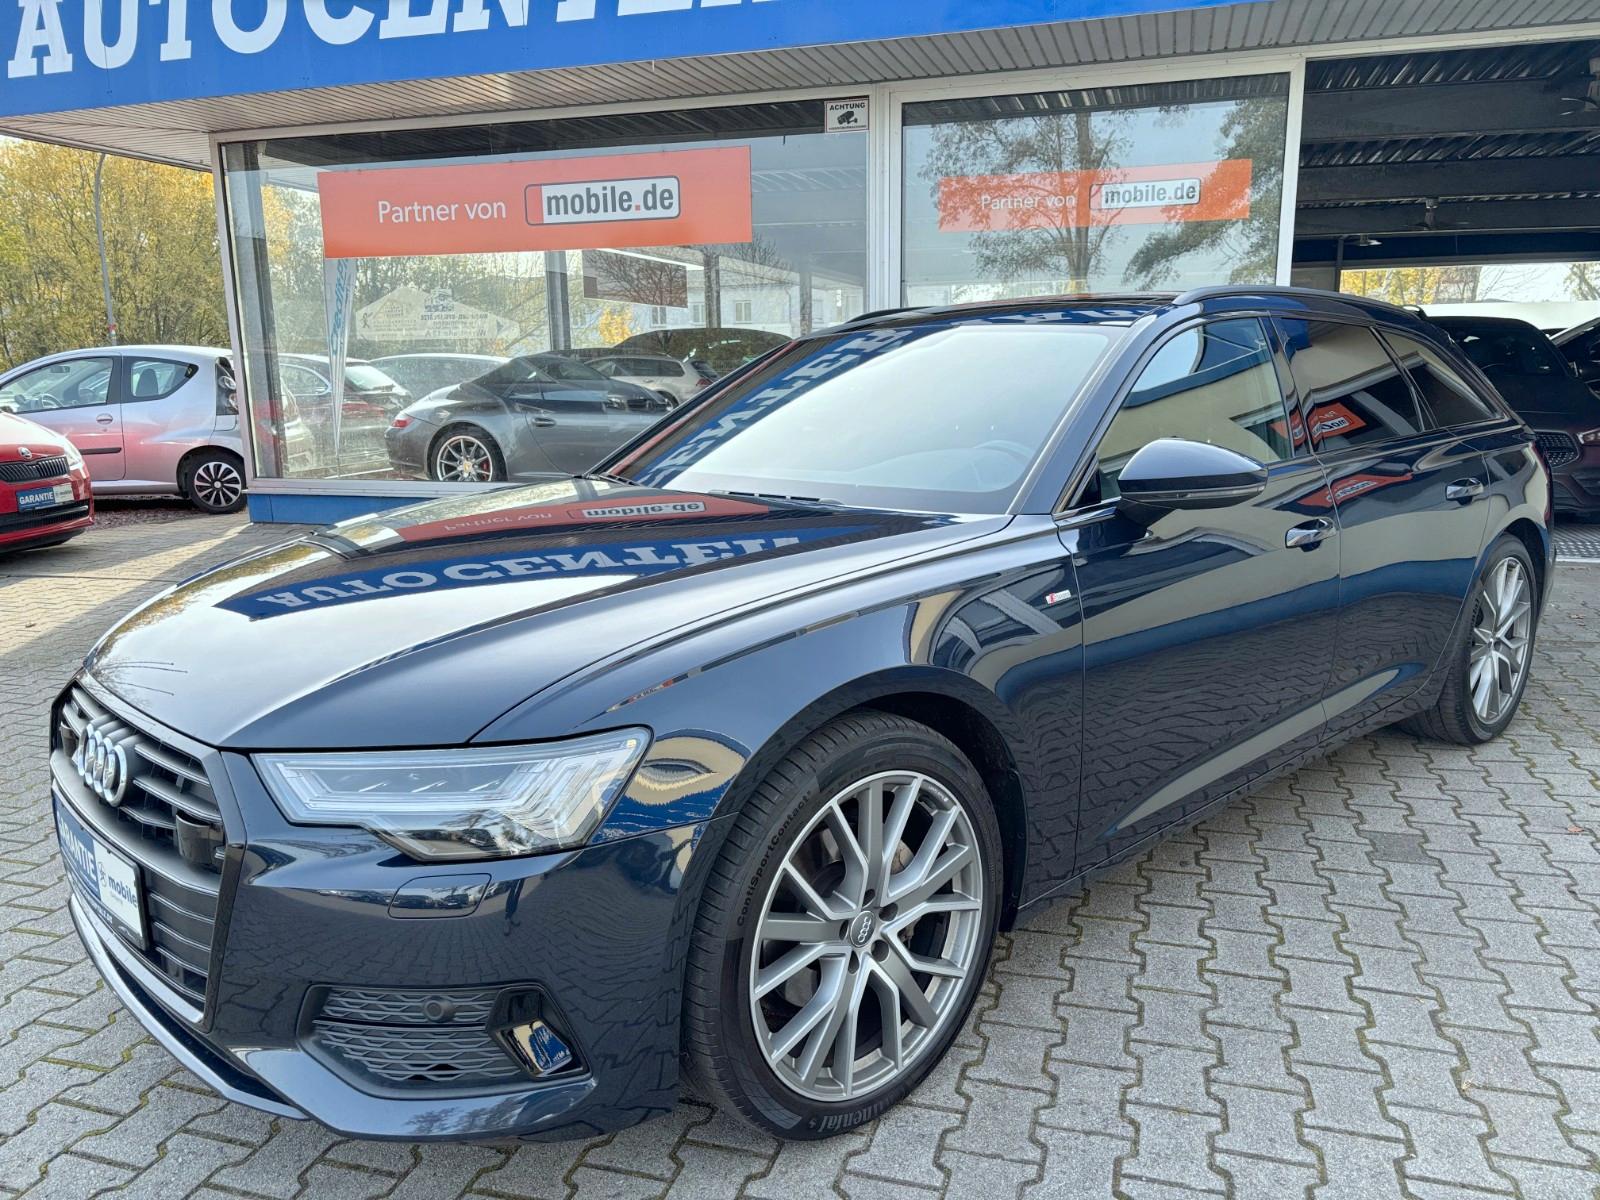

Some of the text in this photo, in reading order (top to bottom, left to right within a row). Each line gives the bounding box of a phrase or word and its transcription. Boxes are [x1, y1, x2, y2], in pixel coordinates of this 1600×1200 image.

[829, 102, 866, 111] ACHTUNG
[378, 183, 674, 224] Partner von mobile.de
[981, 181, 1196, 210] Partner von mobile.de
[20, 491, 54, 505] GARANTIE
[108, 874, 138, 908] mobile
